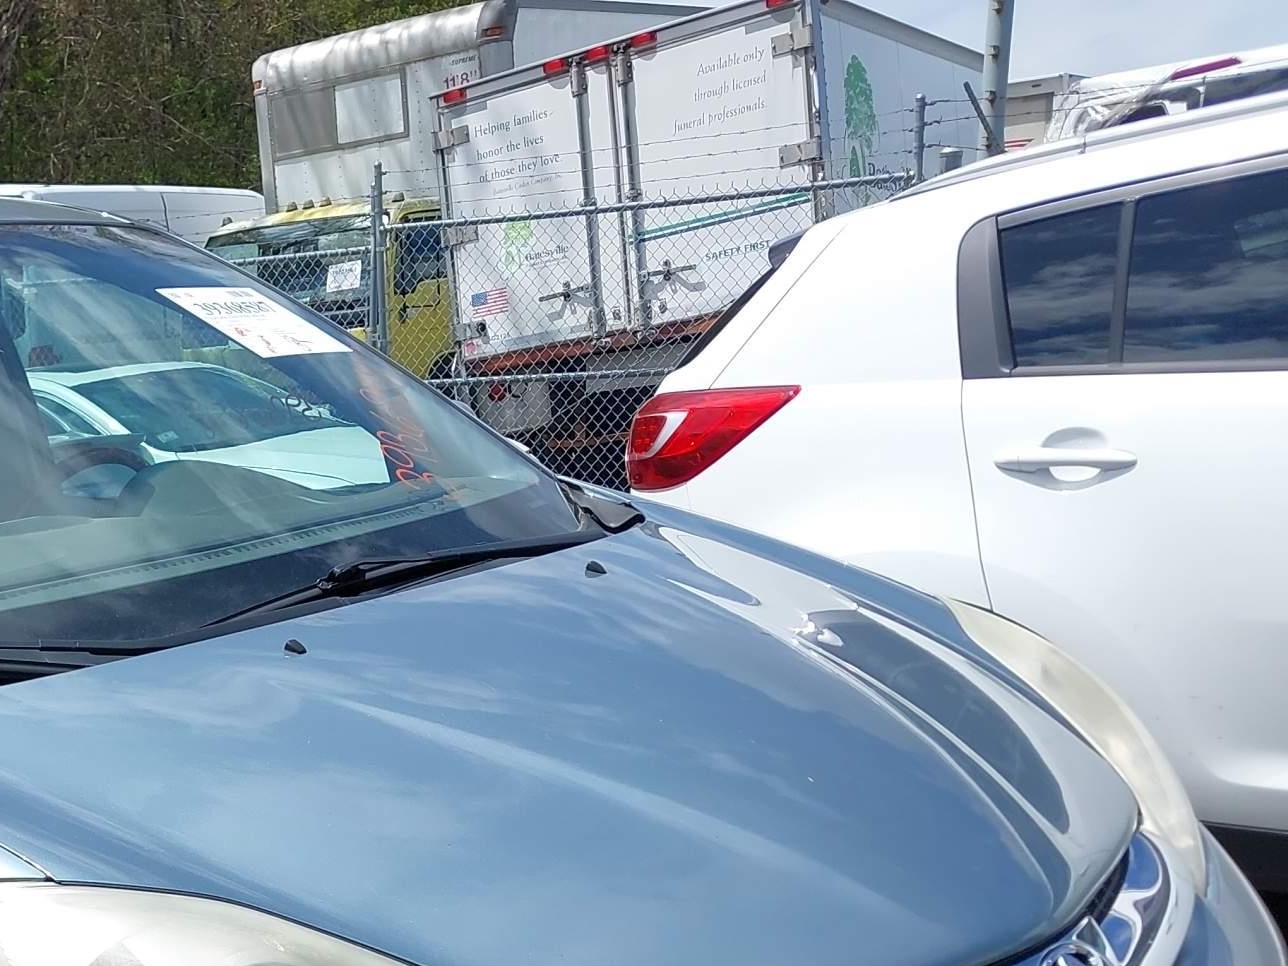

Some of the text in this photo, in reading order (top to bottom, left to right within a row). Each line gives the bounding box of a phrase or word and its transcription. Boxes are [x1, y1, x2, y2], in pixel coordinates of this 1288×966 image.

[697, 46, 765, 76] Available only
[694, 69, 767, 102] through licensed
[473, 108, 549, 138] Helping families
[674, 112, 705, 136] funeral
[476, 134, 545, 160] honor the lives
[479, 153, 560, 183] of those they love
[705, 239, 770, 261] SAFETY FIRST
